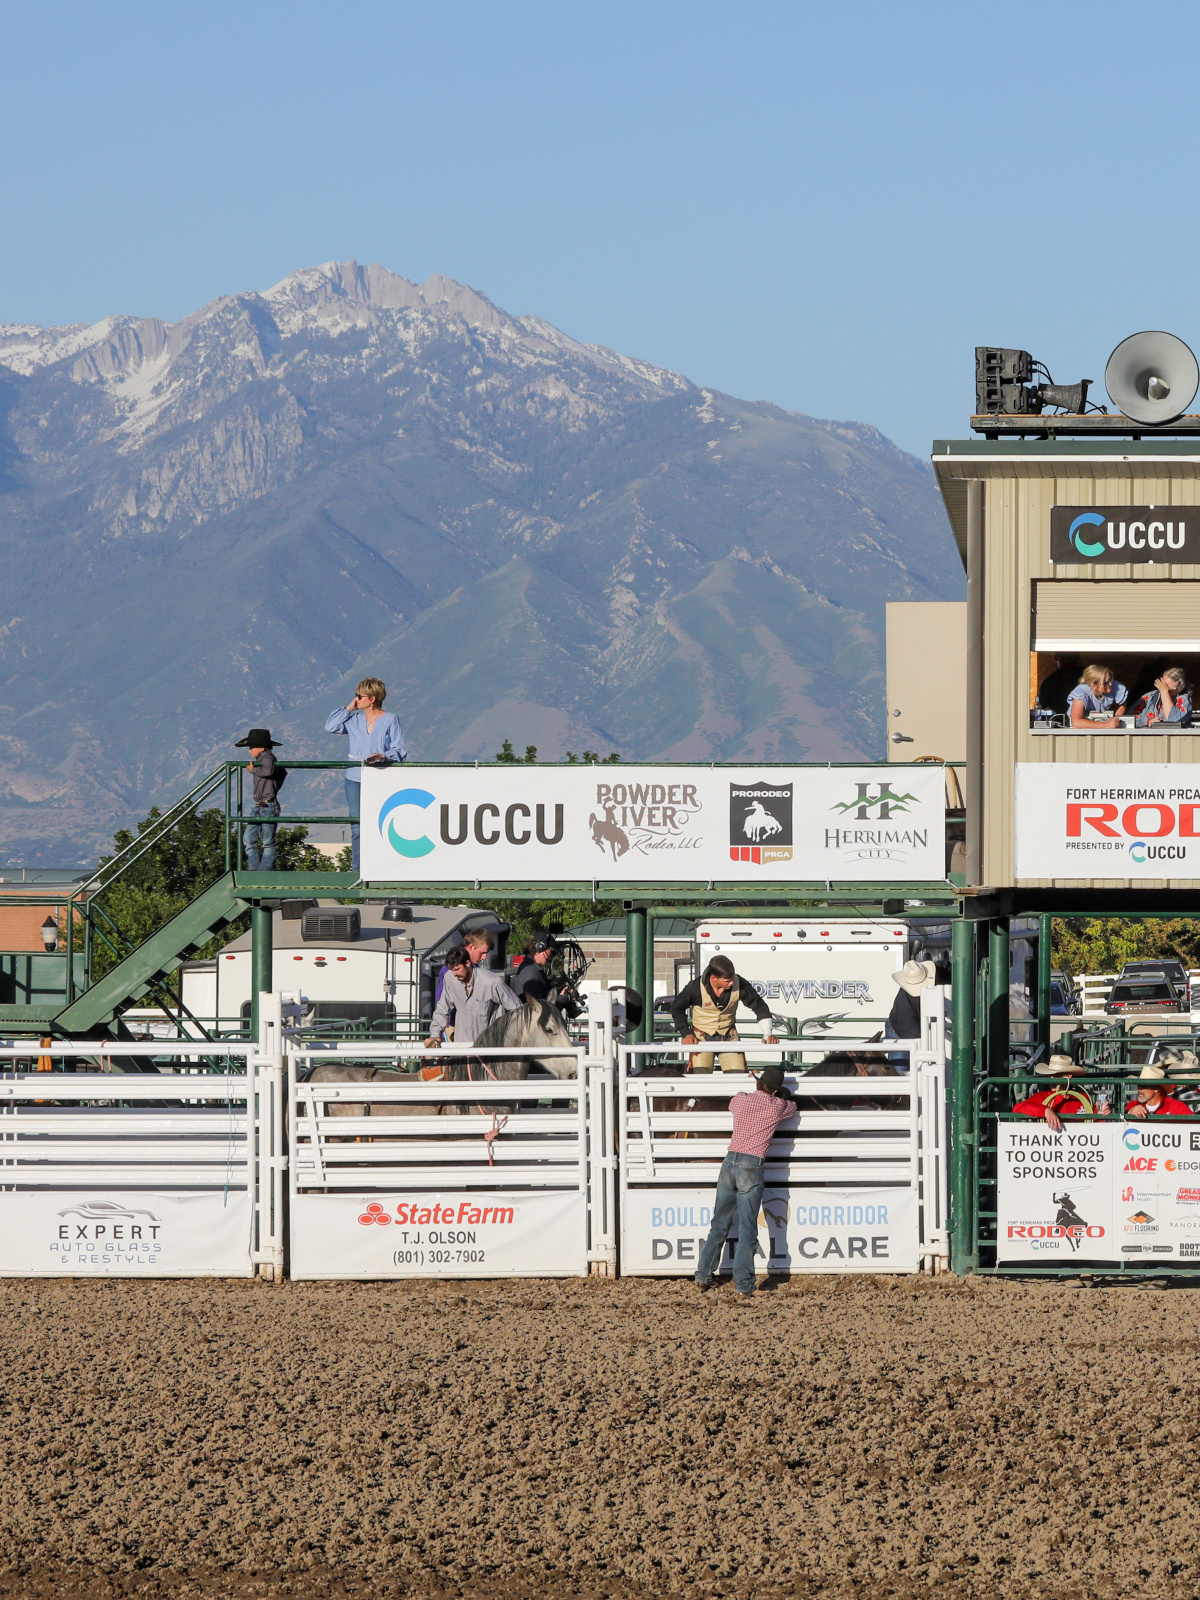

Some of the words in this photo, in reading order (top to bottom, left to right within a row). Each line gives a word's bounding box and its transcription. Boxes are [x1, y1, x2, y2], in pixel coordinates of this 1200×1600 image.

[1107, 522, 1186, 549] UCCU
[596, 783, 700, 807] POWDER
[732, 790, 790, 798] PRORODEO
[1066, 788, 1097, 800] FORT
[1100, 788, 1164, 800] HERRIMAN
[1170, 788, 1200, 800] PRCA
[440, 803, 564, 846] UCCU
[824, 828, 928, 848] HERRIMAN
[858, 850, 894, 858] CITY
[1066, 842, 1112, 850] PRESENTED
[1114, 842, 1124, 850] BY
[1148, 846, 1186, 859] UCCU
[749, 980, 874, 1003] DEWINDER
[1009, 1134, 1063, 1146] THANK
[1068, 1134, 1100, 1146] YOU
[1142, 1134, 1181, 1148] UCCU
[1005, 1150, 1026, 1162] TO
[1030, 1150, 1063, 1162] OUR
[1068, 1150, 1104, 1162] 2025
[1124, 1156, 1158, 1172] ACE
[1012, 1166, 1097, 1178] SPONSORS
[652, 1206, 715, 1228] BOULD
[796, 1205, 889, 1226] CORRIDOR
[58, 1225, 161, 1240] EXPERT
[402, 1232, 424, 1244] T.J.
[428, 1231, 476, 1244] OLSON
[1008, 1226, 1105, 1238] RODEO
[50, 1242, 96, 1252] AUTO
[104, 1242, 162, 1252] GLASS
[652, 1238, 786, 1260] DETL
[798, 1236, 890, 1259] CARE
[61, 1256, 68, 1264] &
[78, 1254, 157, 1264] RESTYLE
[393, 1250, 425, 1266] (801)
[428, 1250, 486, 1264] 302-7902
